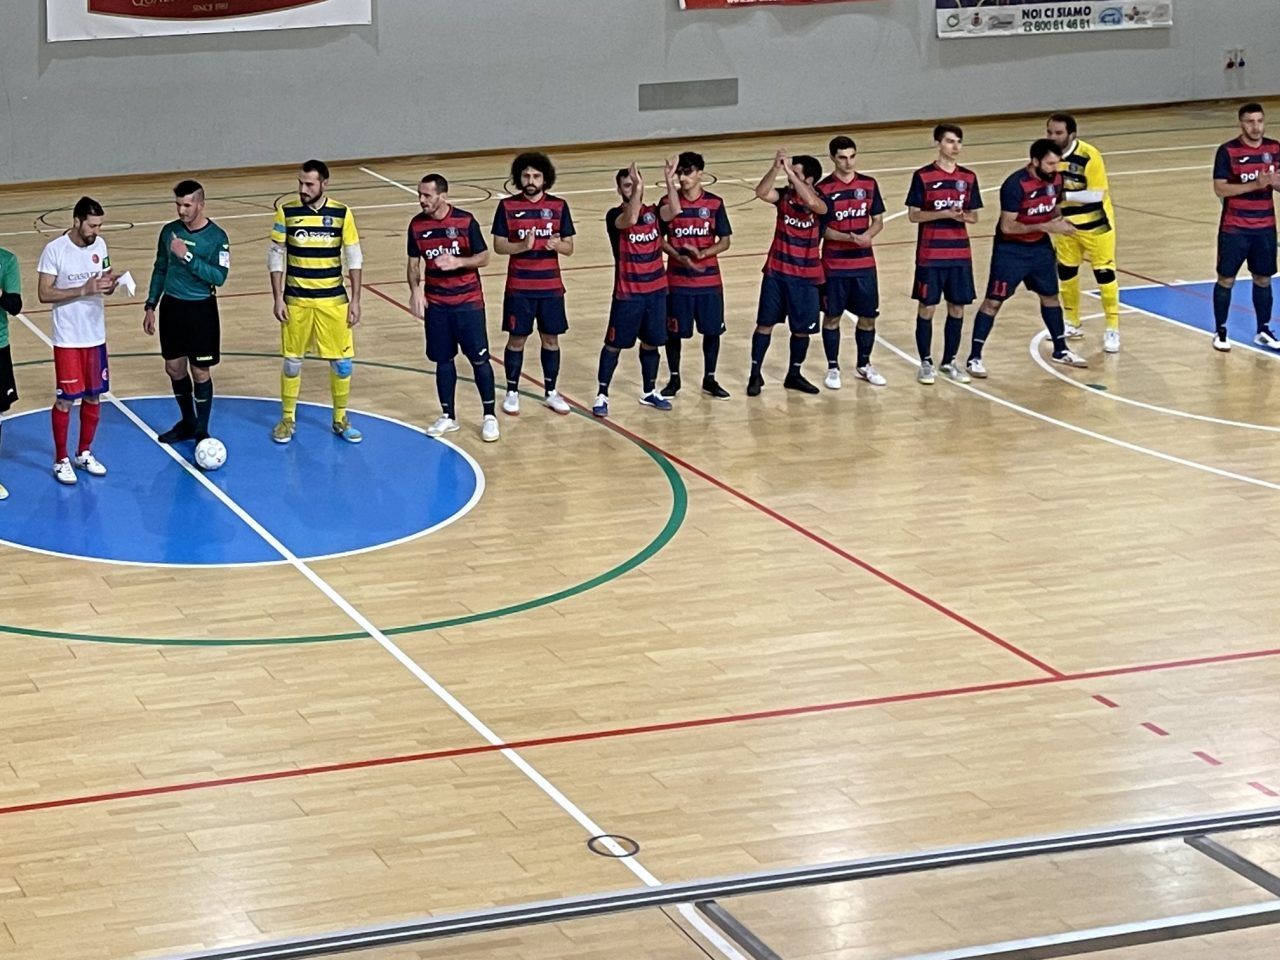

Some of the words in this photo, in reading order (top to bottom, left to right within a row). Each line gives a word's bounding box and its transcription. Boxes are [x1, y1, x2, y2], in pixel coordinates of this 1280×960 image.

[1022, 8, 1042, 19] NOI
[1045, 8, 1054, 18] CI
[1057, 6, 1091, 18] SIAMO
